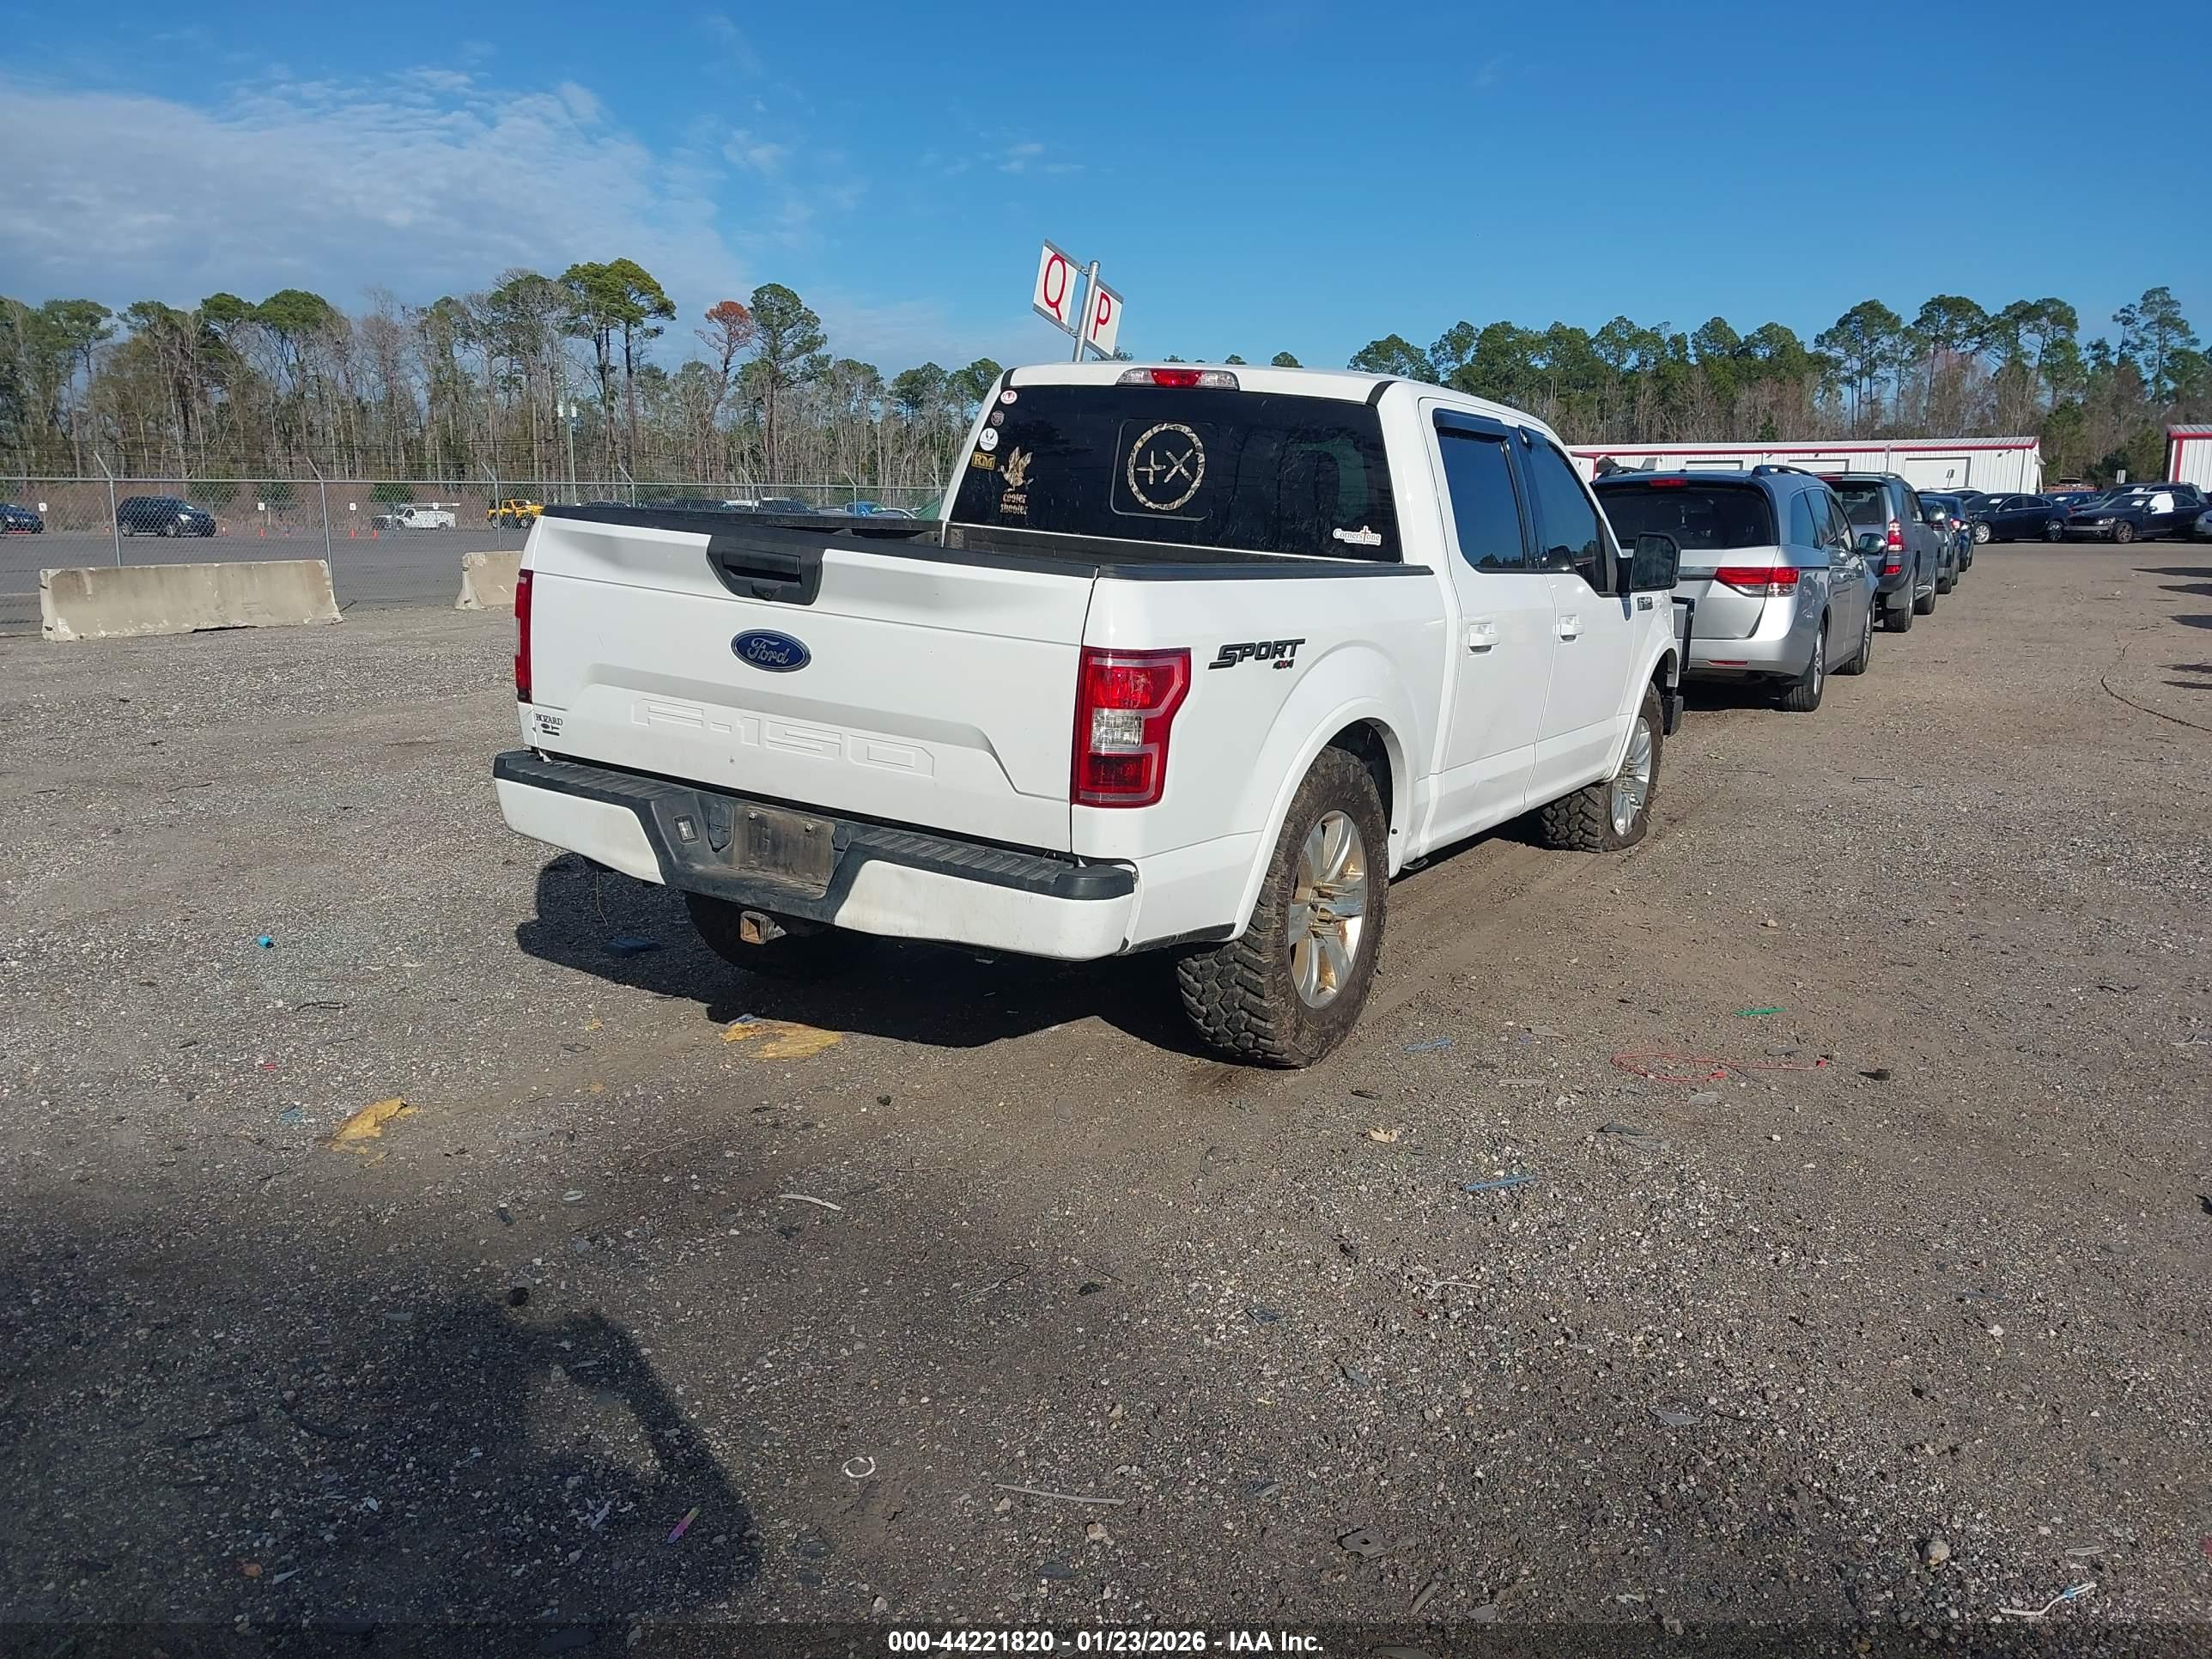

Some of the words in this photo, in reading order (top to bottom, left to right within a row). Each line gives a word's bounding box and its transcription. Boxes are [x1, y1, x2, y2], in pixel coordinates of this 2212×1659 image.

[1043, 252, 1066, 322] Q
[1092, 291, 1112, 341] P
[746, 637, 791, 664] Ford
[1207, 638, 1306, 671] SPORT
[631, 697, 934, 779] F-150
